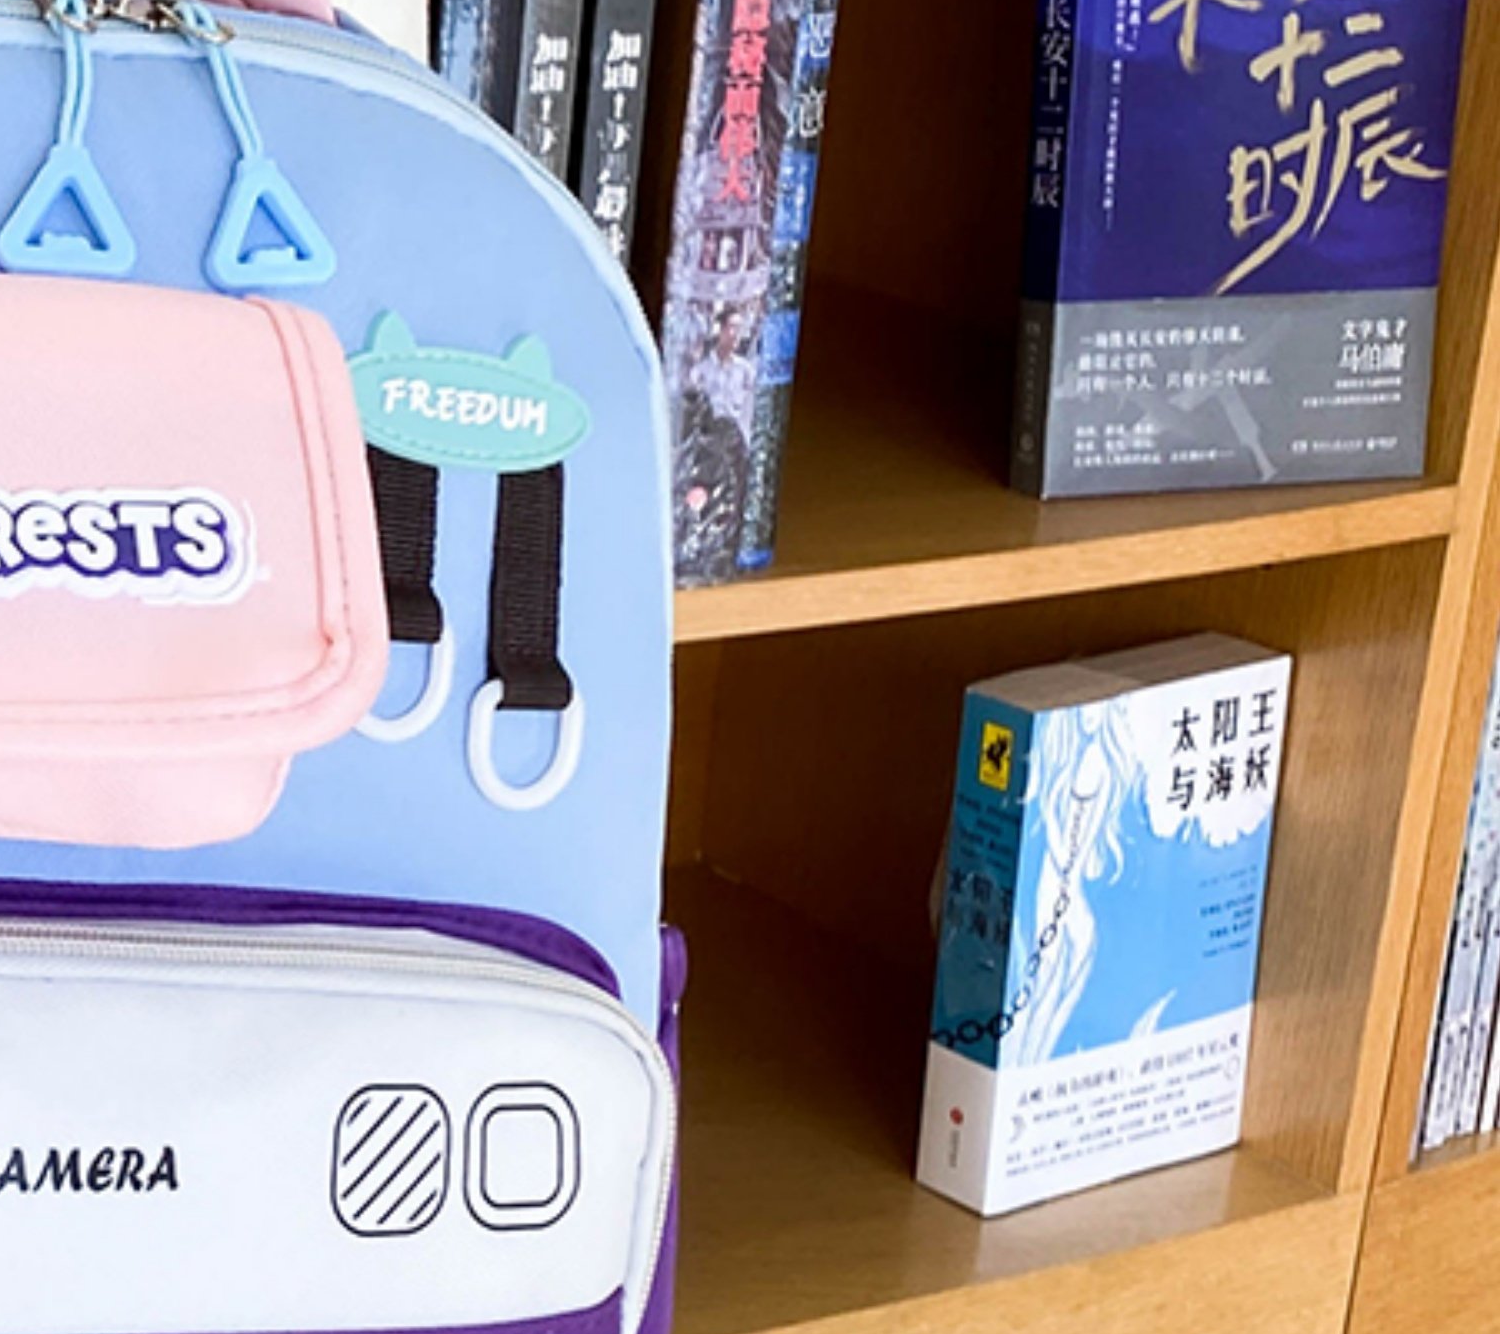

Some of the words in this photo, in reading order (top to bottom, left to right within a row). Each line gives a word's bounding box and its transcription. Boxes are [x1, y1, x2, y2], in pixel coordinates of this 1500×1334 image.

[1249, 12, 1404, 113] 十二
[1213, 87, 1449, 295] 时辰
[1339, 341, 1406, 374] 马伯庸
[381, 376, 548, 437] FREEDUM
[1174, 688, 1277, 757] 太阳王
[1166, 744, 1271, 811] 与海妖
